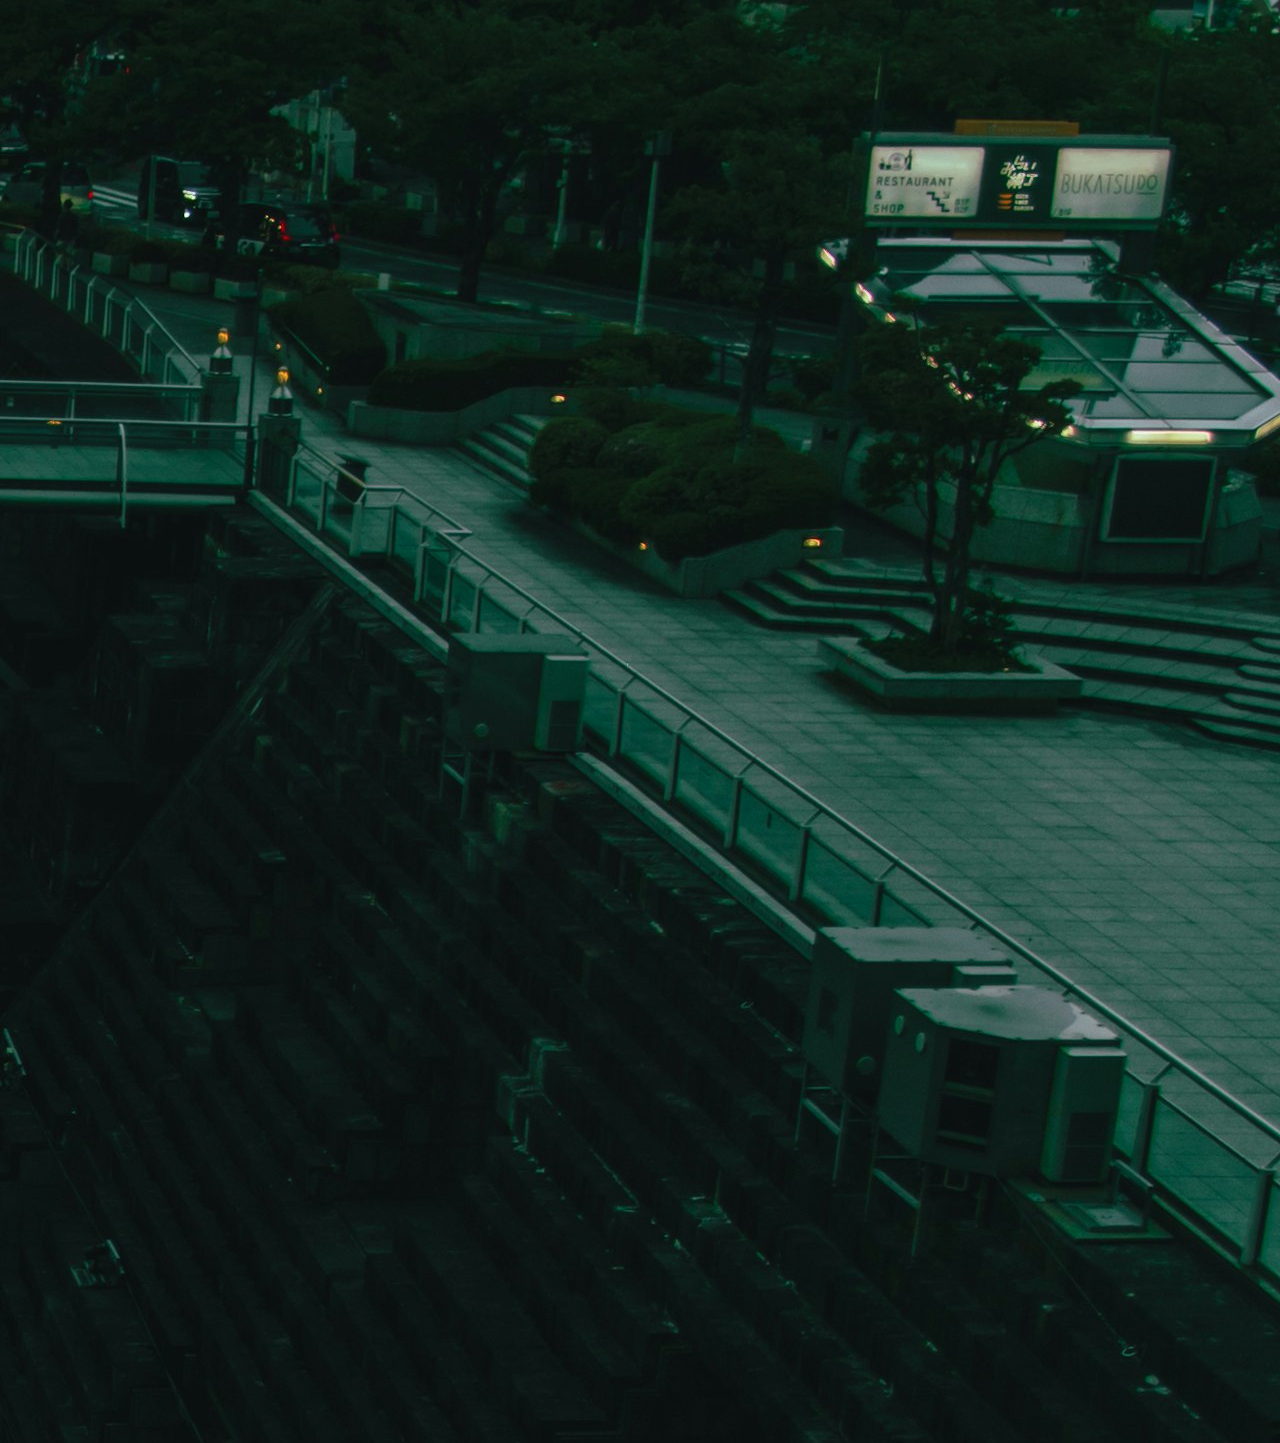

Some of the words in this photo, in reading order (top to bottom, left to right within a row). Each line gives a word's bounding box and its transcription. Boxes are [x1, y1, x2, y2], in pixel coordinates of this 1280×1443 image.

[876, 176, 954, 187] RESTAURANT
[1061, 173, 1159, 195] BUKATSUDO
[875, 190, 883, 200] &
[873, 203, 905, 214] SHOP
